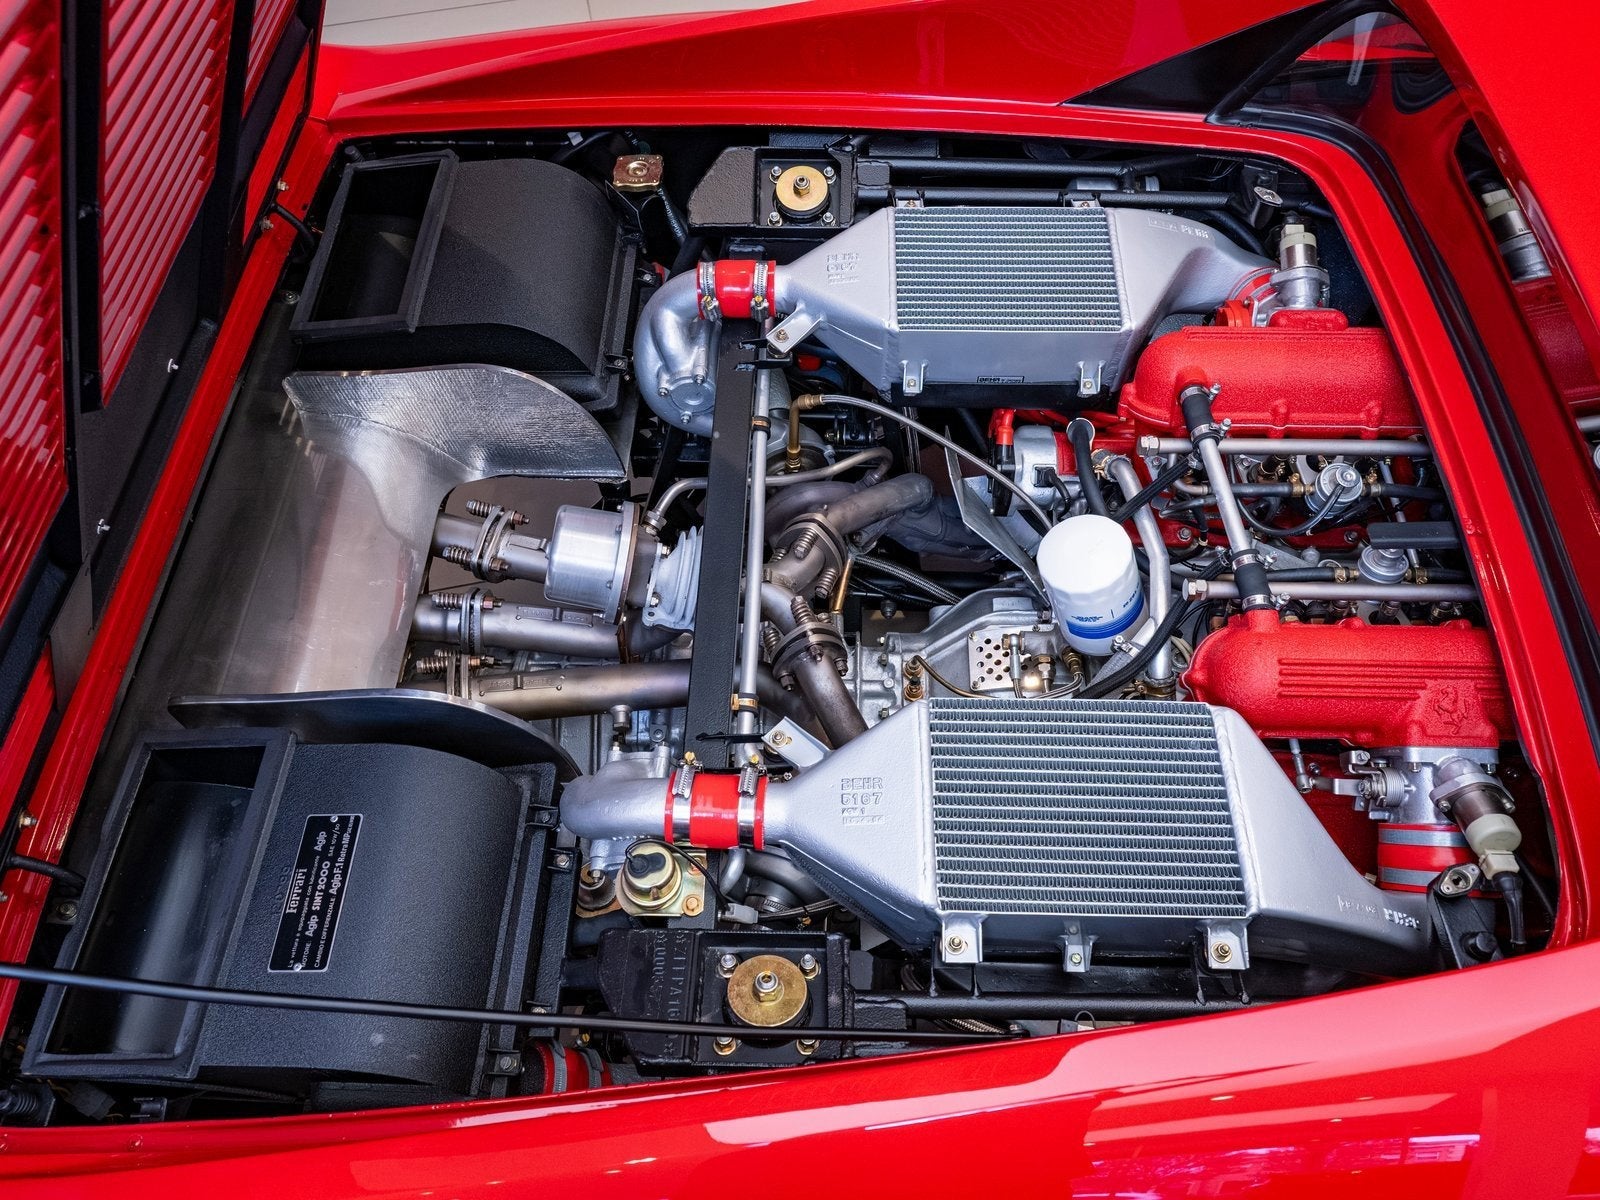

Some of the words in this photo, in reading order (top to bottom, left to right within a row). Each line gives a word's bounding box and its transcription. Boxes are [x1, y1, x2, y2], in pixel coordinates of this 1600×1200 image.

[841, 777, 884, 790] BEHR
[840, 792, 883, 805] 5167
[314, 831, 327, 851] Agip
[317, 861, 330, 890] 2000
[329, 874, 342, 895] Agip
[286, 869, 307, 913] Ferrari
[312, 891, 323, 910] SINT
[305, 915, 319, 937] Agip
